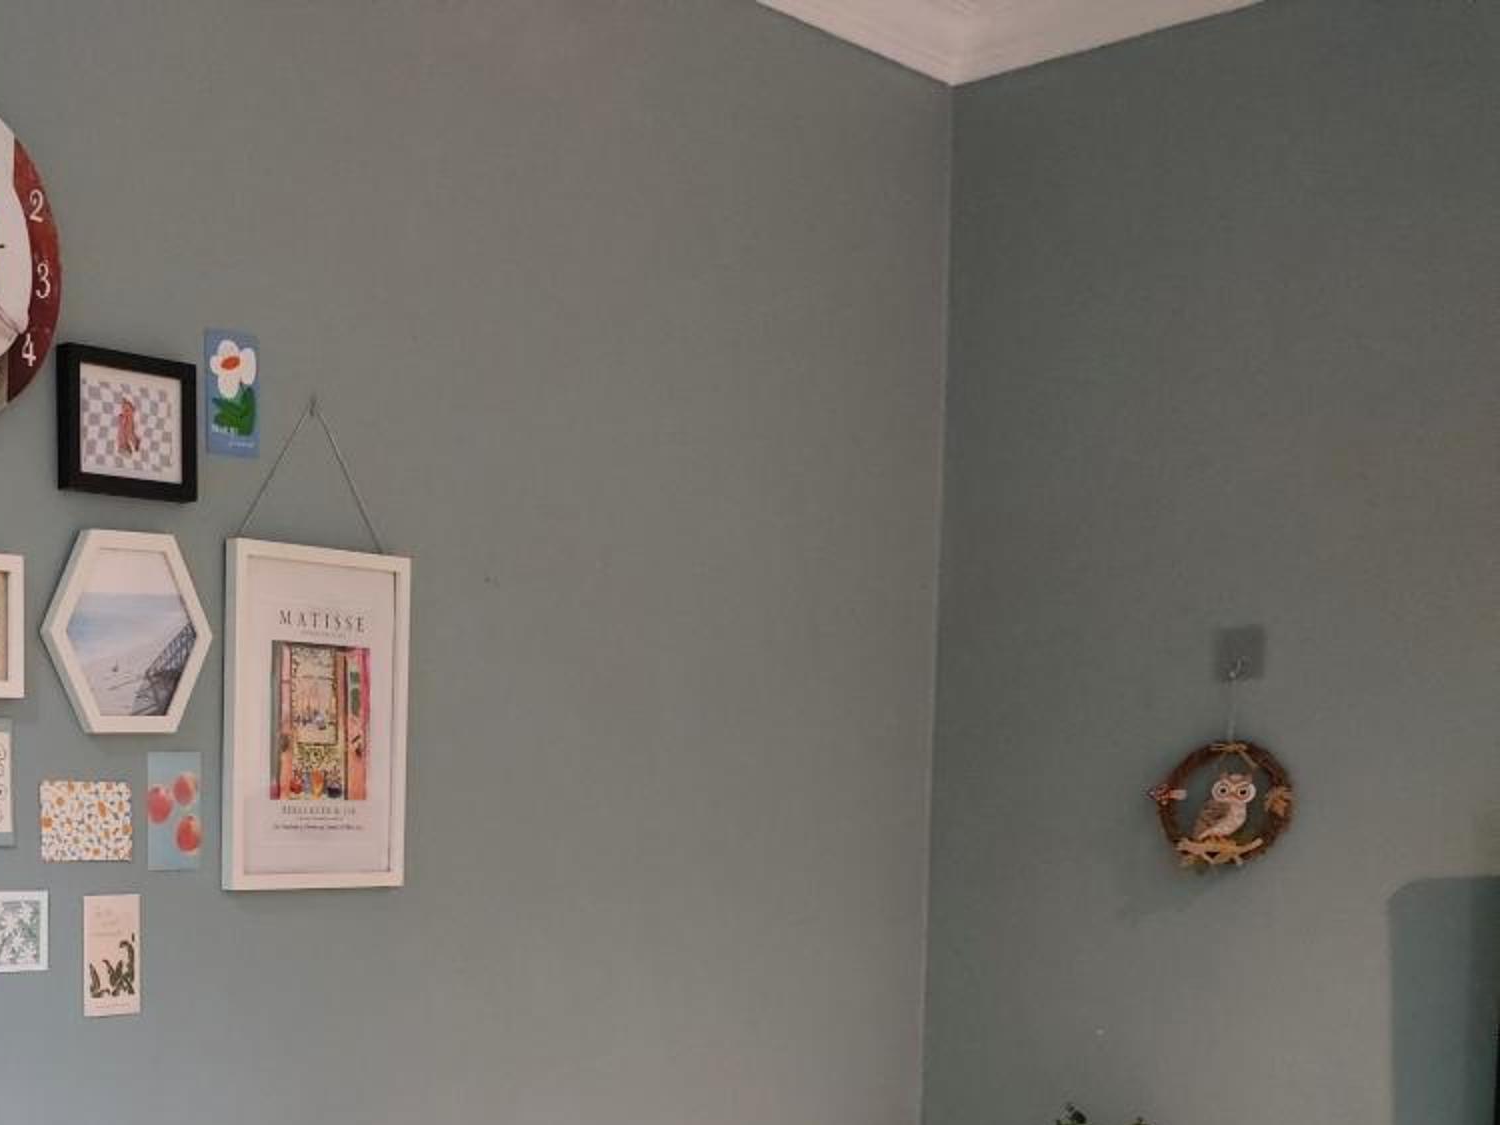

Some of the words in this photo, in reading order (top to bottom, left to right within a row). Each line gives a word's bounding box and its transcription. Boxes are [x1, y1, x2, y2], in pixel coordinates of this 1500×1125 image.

[28, 188, 44, 223] 2
[35, 262, 51, 299] 3
[21, 332, 37, 367] 4
[278, 608, 367, 634] MATISSE
